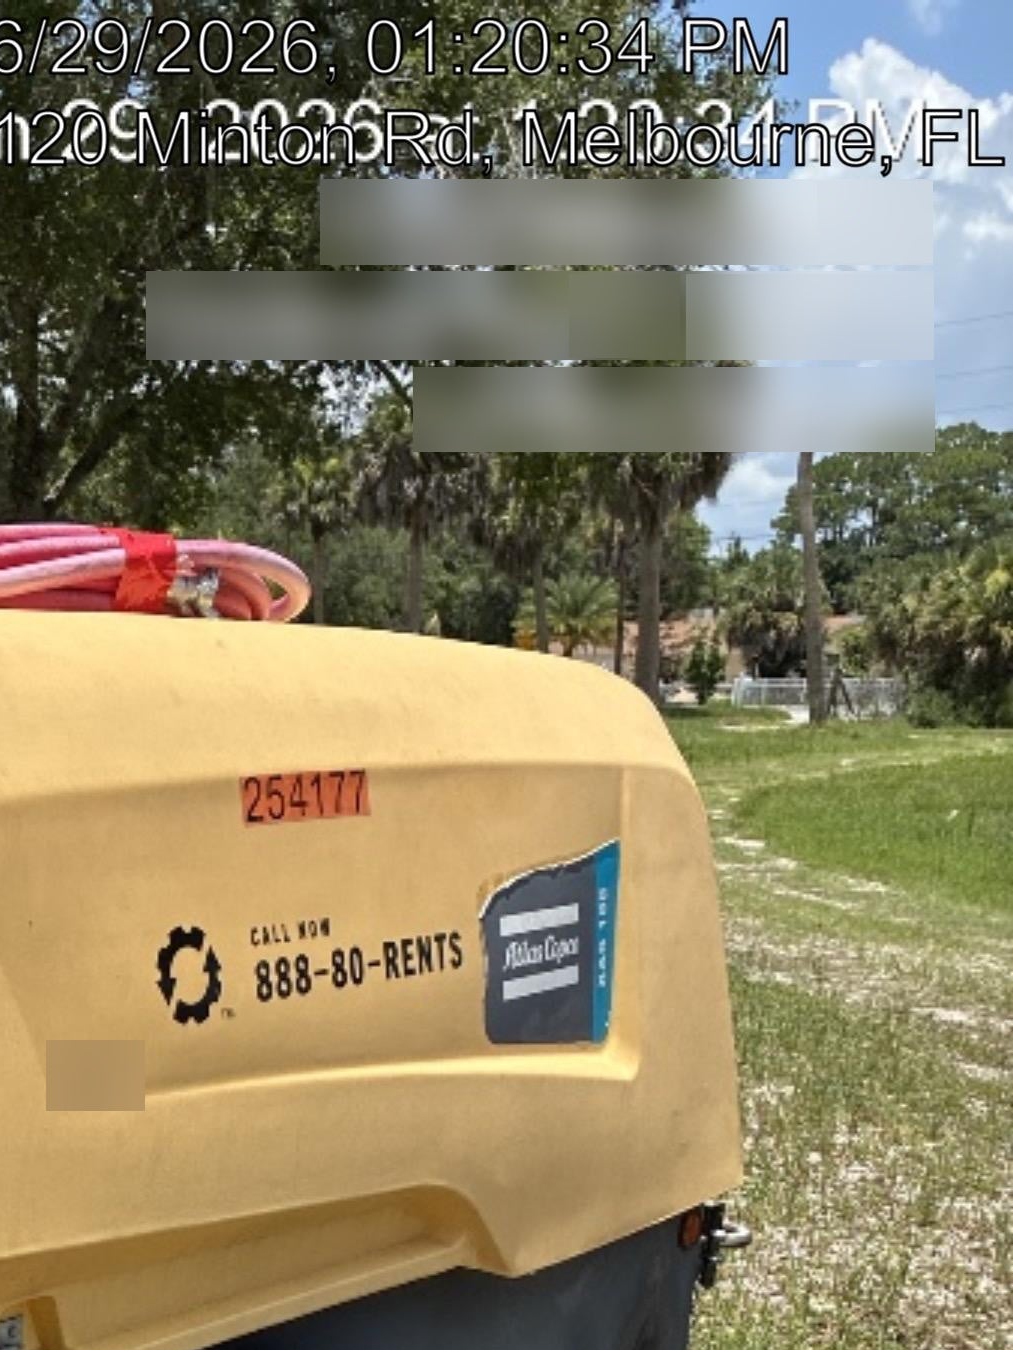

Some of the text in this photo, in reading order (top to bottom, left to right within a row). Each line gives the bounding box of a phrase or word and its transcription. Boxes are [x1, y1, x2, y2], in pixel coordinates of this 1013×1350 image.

[243, 769, 366, 822] 254177
[250, 917, 330, 946] CALL NOW
[255, 932, 463, 1002] 888-80-RENTS
